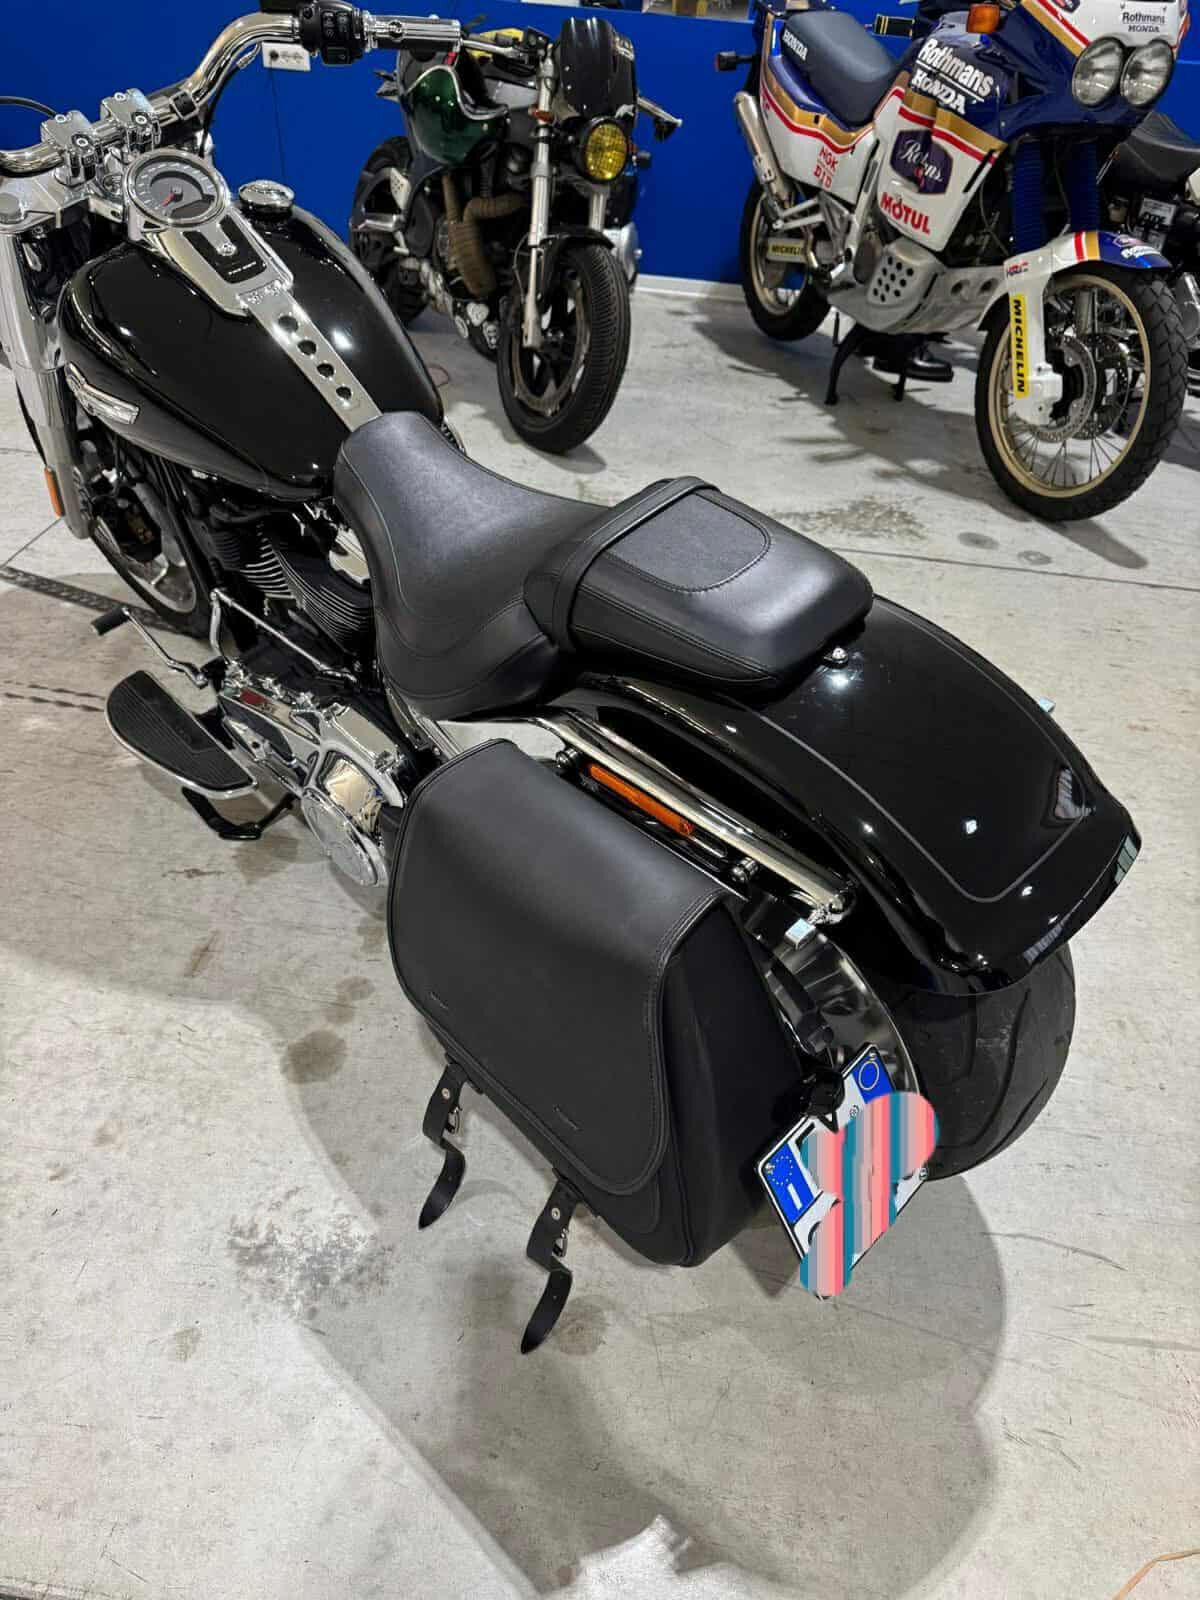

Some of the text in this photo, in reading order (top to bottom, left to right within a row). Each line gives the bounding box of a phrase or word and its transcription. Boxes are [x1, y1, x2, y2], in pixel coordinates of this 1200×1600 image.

[1123, 12, 1166, 24] Rothmans
[1128, 25, 1160, 33] HONDA
[782, 28, 809, 61] HONDA
[916, 38, 995, 97] Rothmans
[911, 70, 966, 115] HONDA
[880, 191, 931, 234] MOTUL
[1013, 298, 1026, 393] MICHELIN
